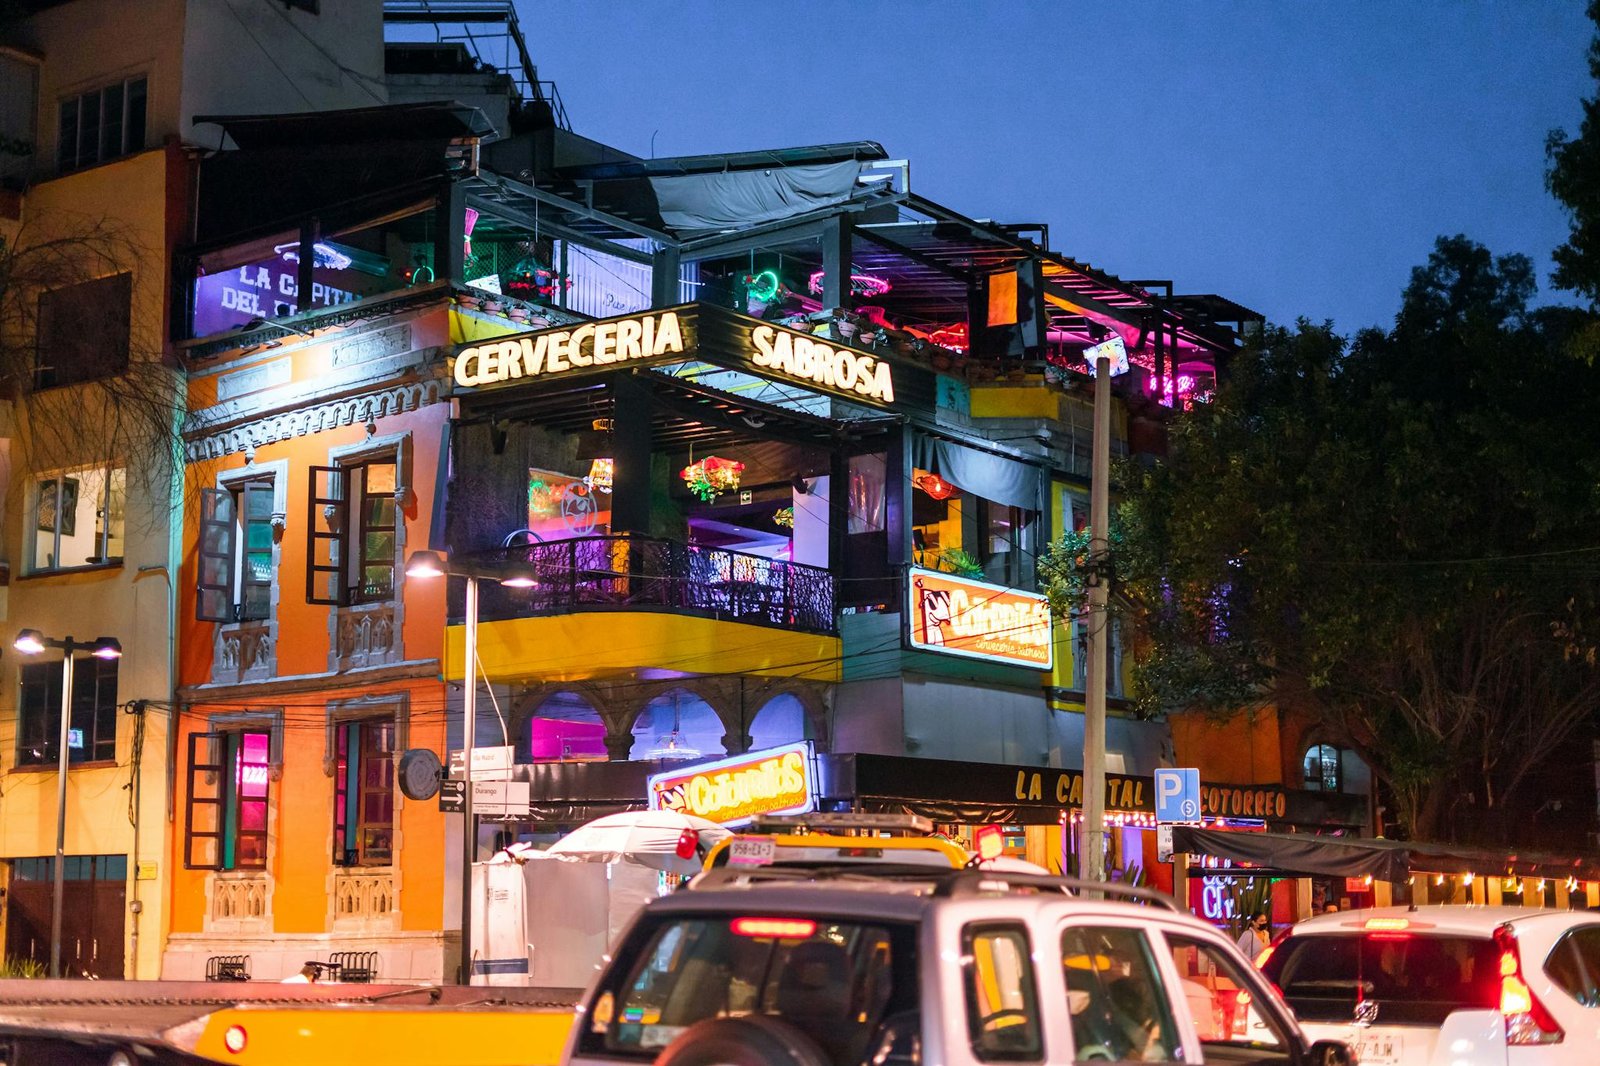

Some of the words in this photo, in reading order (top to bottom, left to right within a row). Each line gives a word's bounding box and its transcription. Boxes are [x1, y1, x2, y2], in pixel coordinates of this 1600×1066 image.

[239, 265, 271, 290] LA
[221, 286, 267, 317] DEL
[453, 312, 684, 388] CERVECERIA
[752, 325, 895, 403] SABROSA
[475, 788, 497, 796] Durango
[1015, 770, 1042, 801] LA
[1056, 774, 1143, 808] CATAL
[1159, 773, 1182, 809] P
